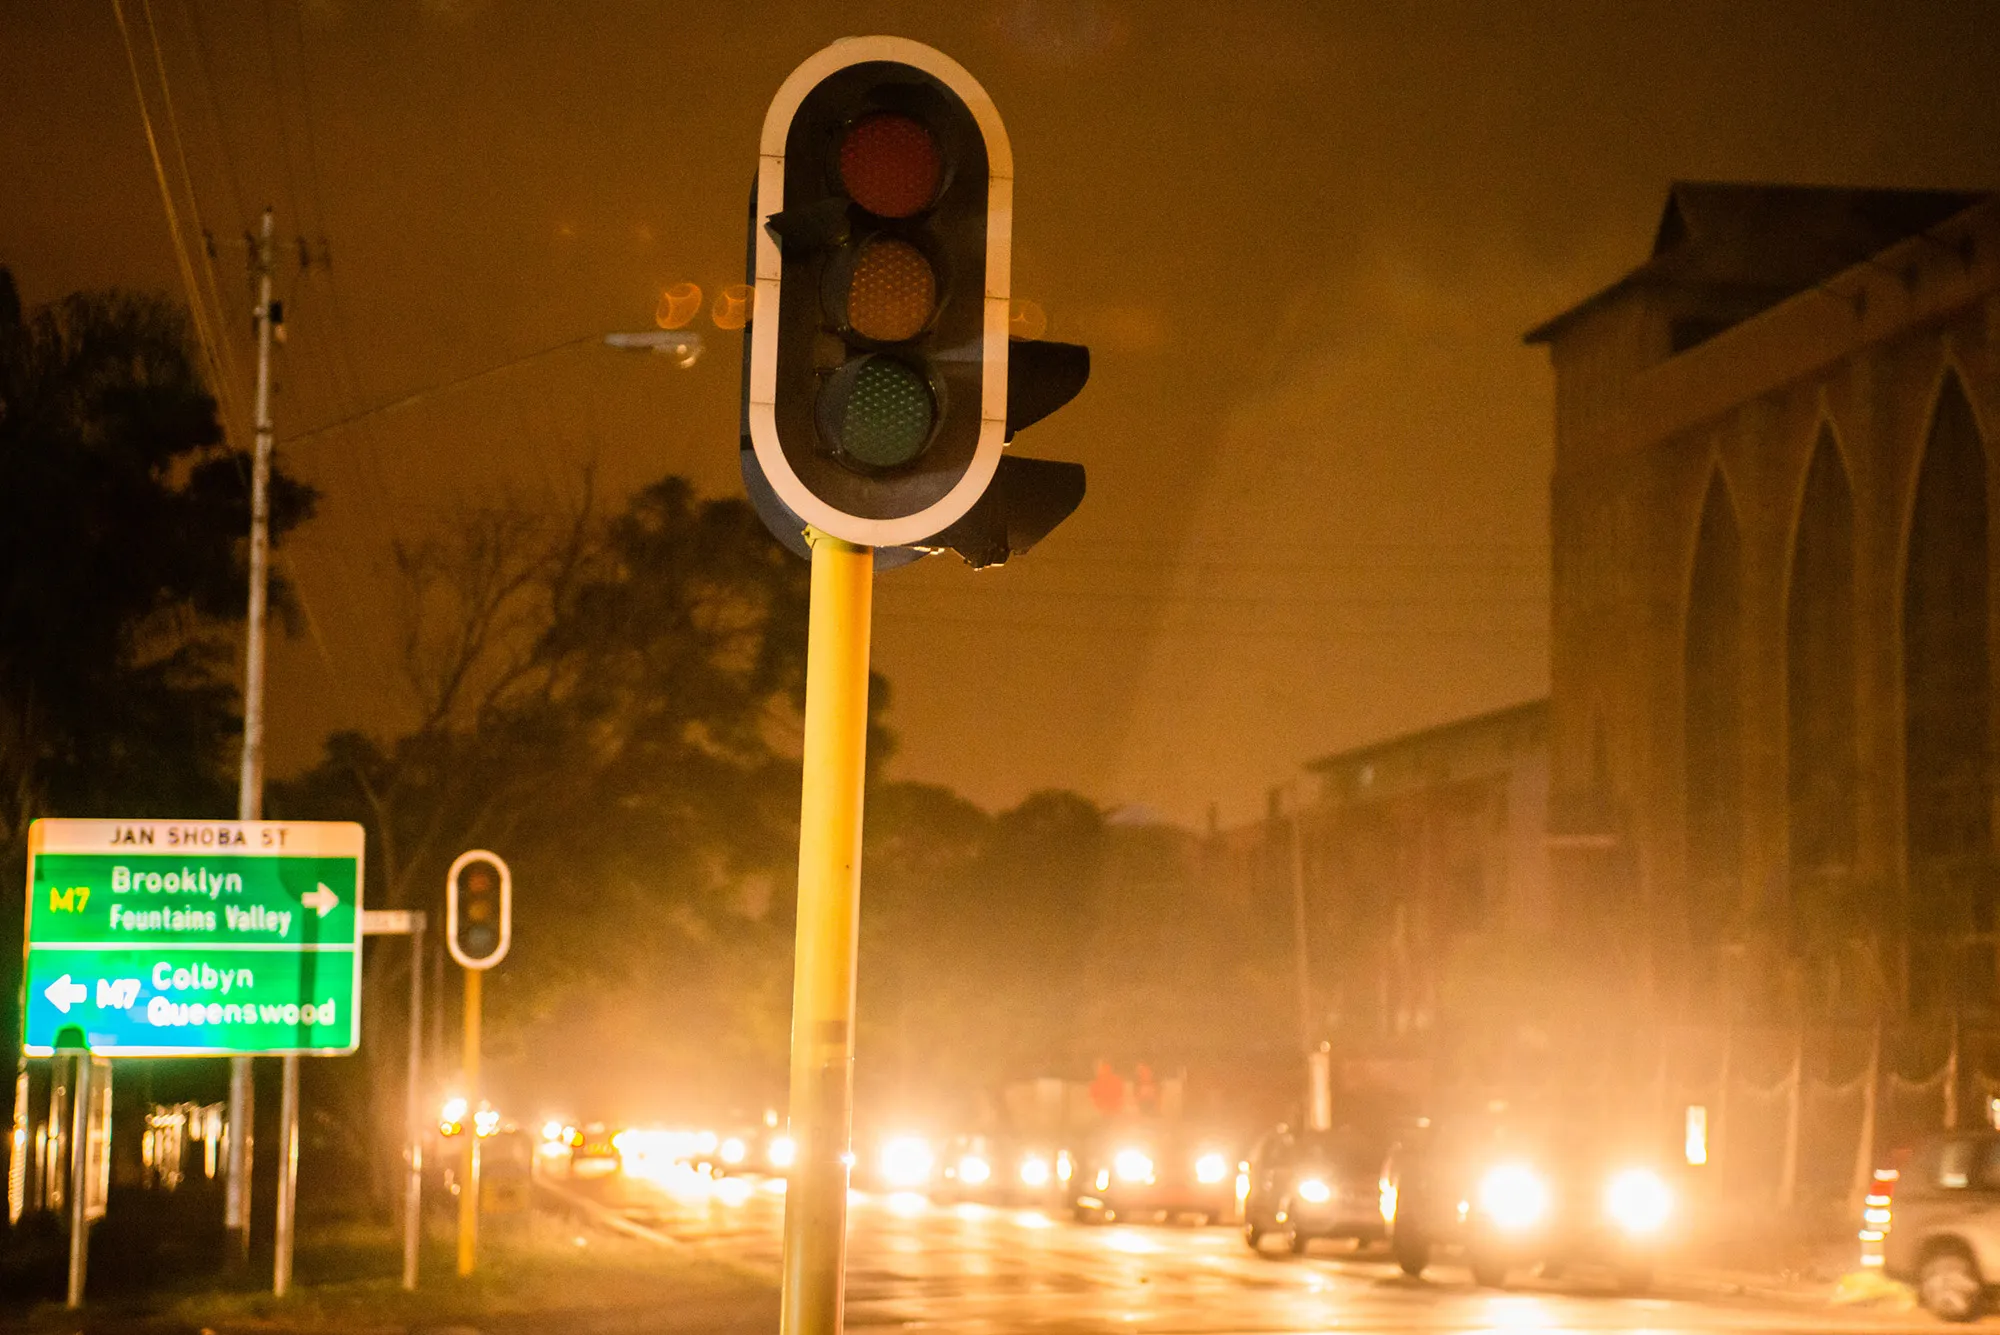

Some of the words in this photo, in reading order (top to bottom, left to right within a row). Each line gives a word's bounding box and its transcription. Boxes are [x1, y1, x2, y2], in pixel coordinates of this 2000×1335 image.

[109, 828, 154, 846] JAN
[168, 828, 246, 846] SHOBA
[261, 828, 288, 846] ST
[111, 866, 242, 899] Brooklyn
[49, 887, 91, 913] M7
[109, 905, 216, 932] Fountains
[225, 905, 292, 937] Valley
[96, 978, 141, 1009] M7
[152, 962, 254, 994] Colbyn
[147, 996, 336, 1027] Queenswood
